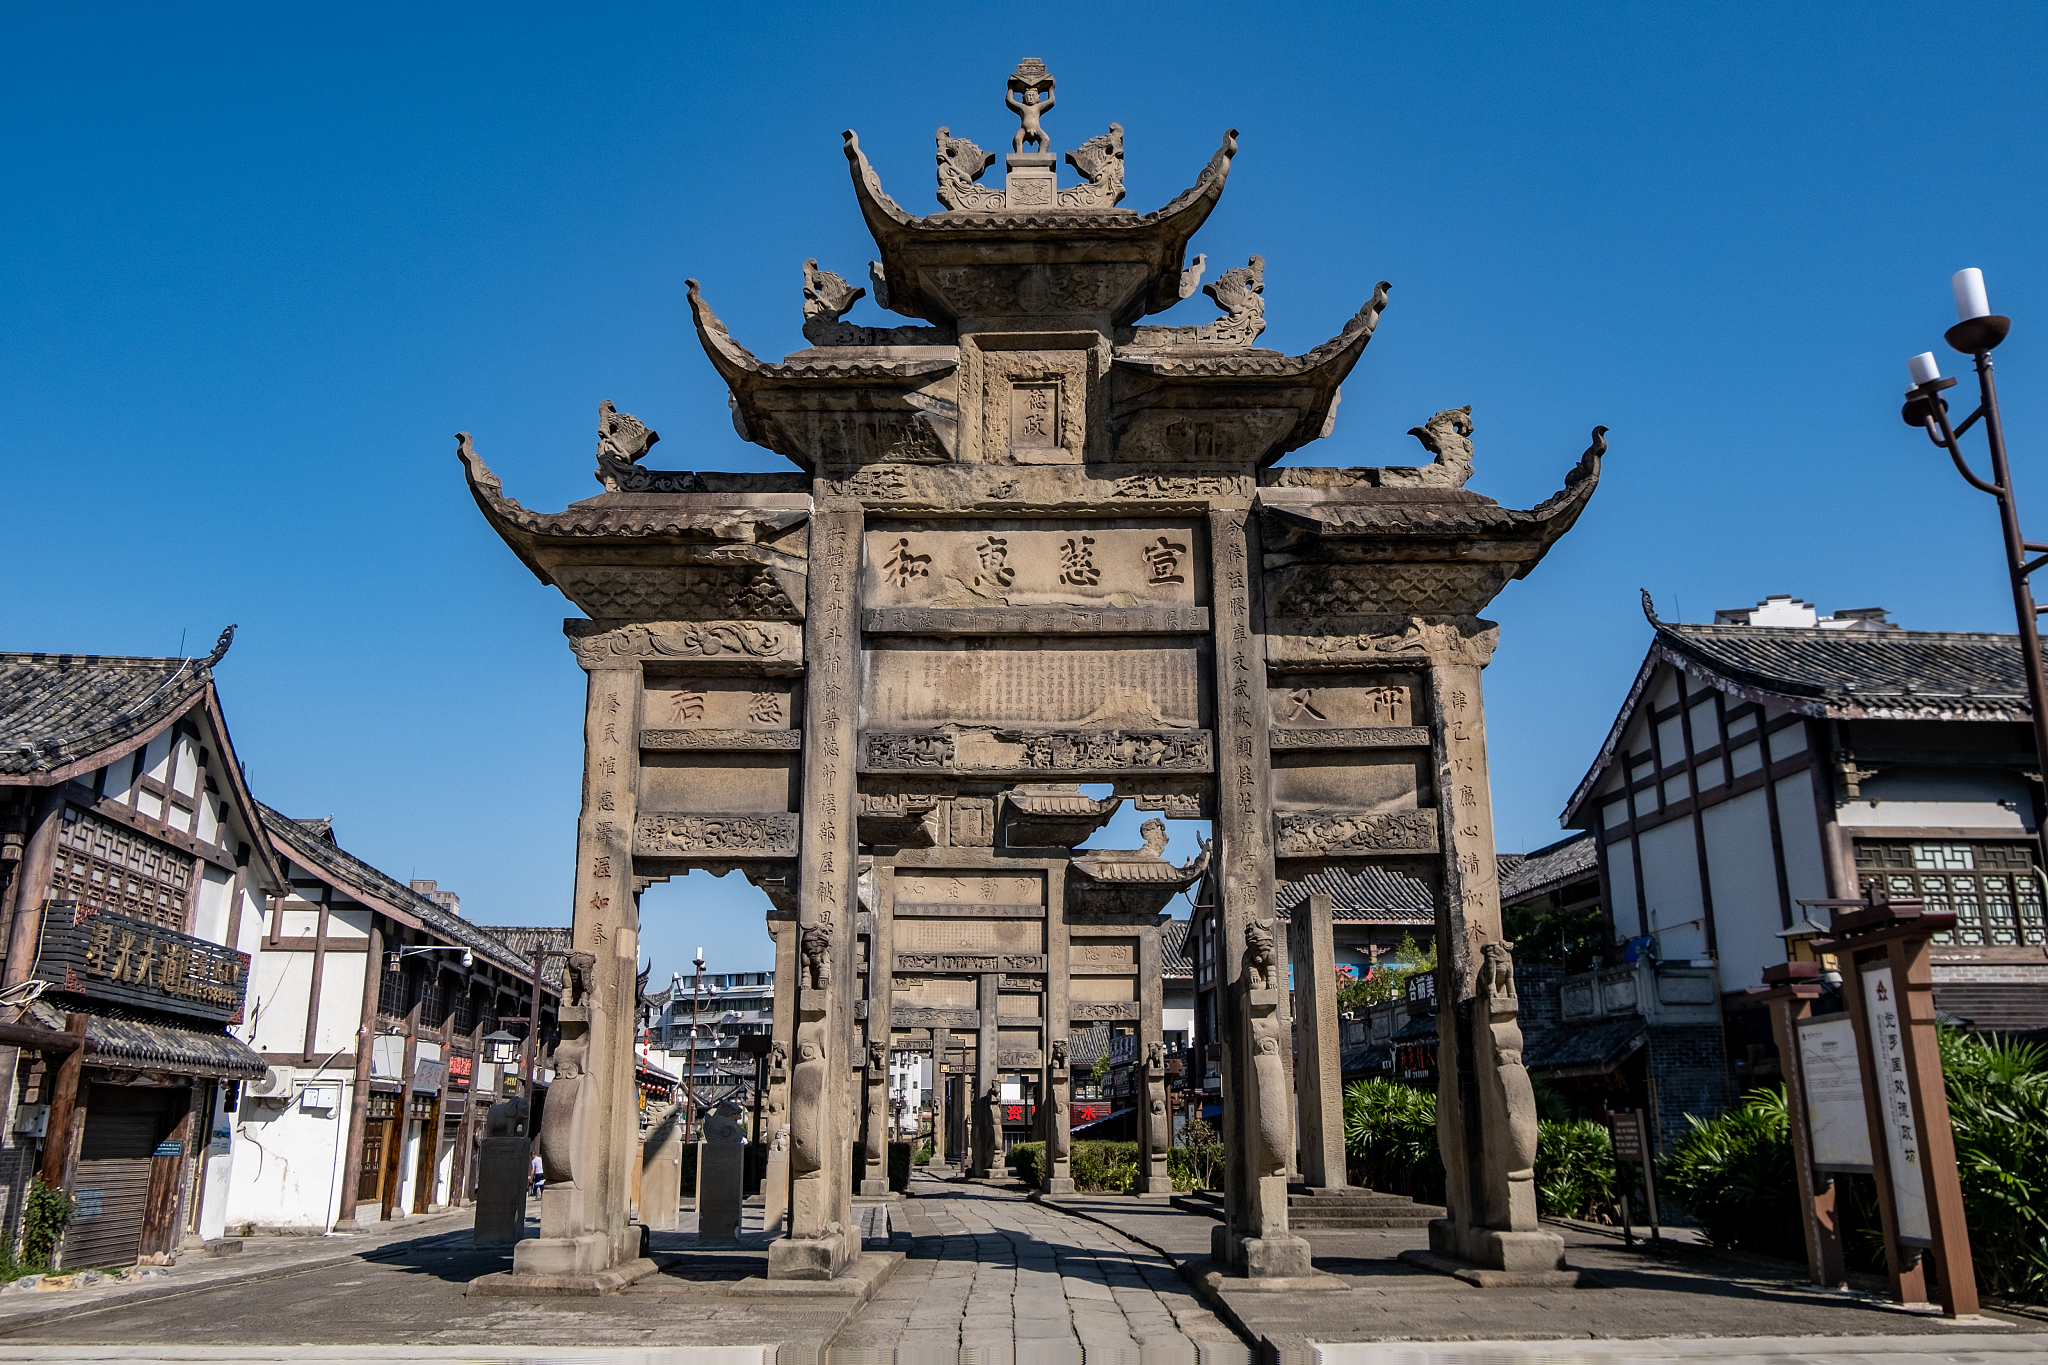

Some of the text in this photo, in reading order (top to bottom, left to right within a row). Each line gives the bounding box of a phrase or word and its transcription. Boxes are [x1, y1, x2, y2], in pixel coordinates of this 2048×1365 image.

[1024, 388, 1047, 437] 德政
[882, 536, 1187, 587] 宣慈惠和
